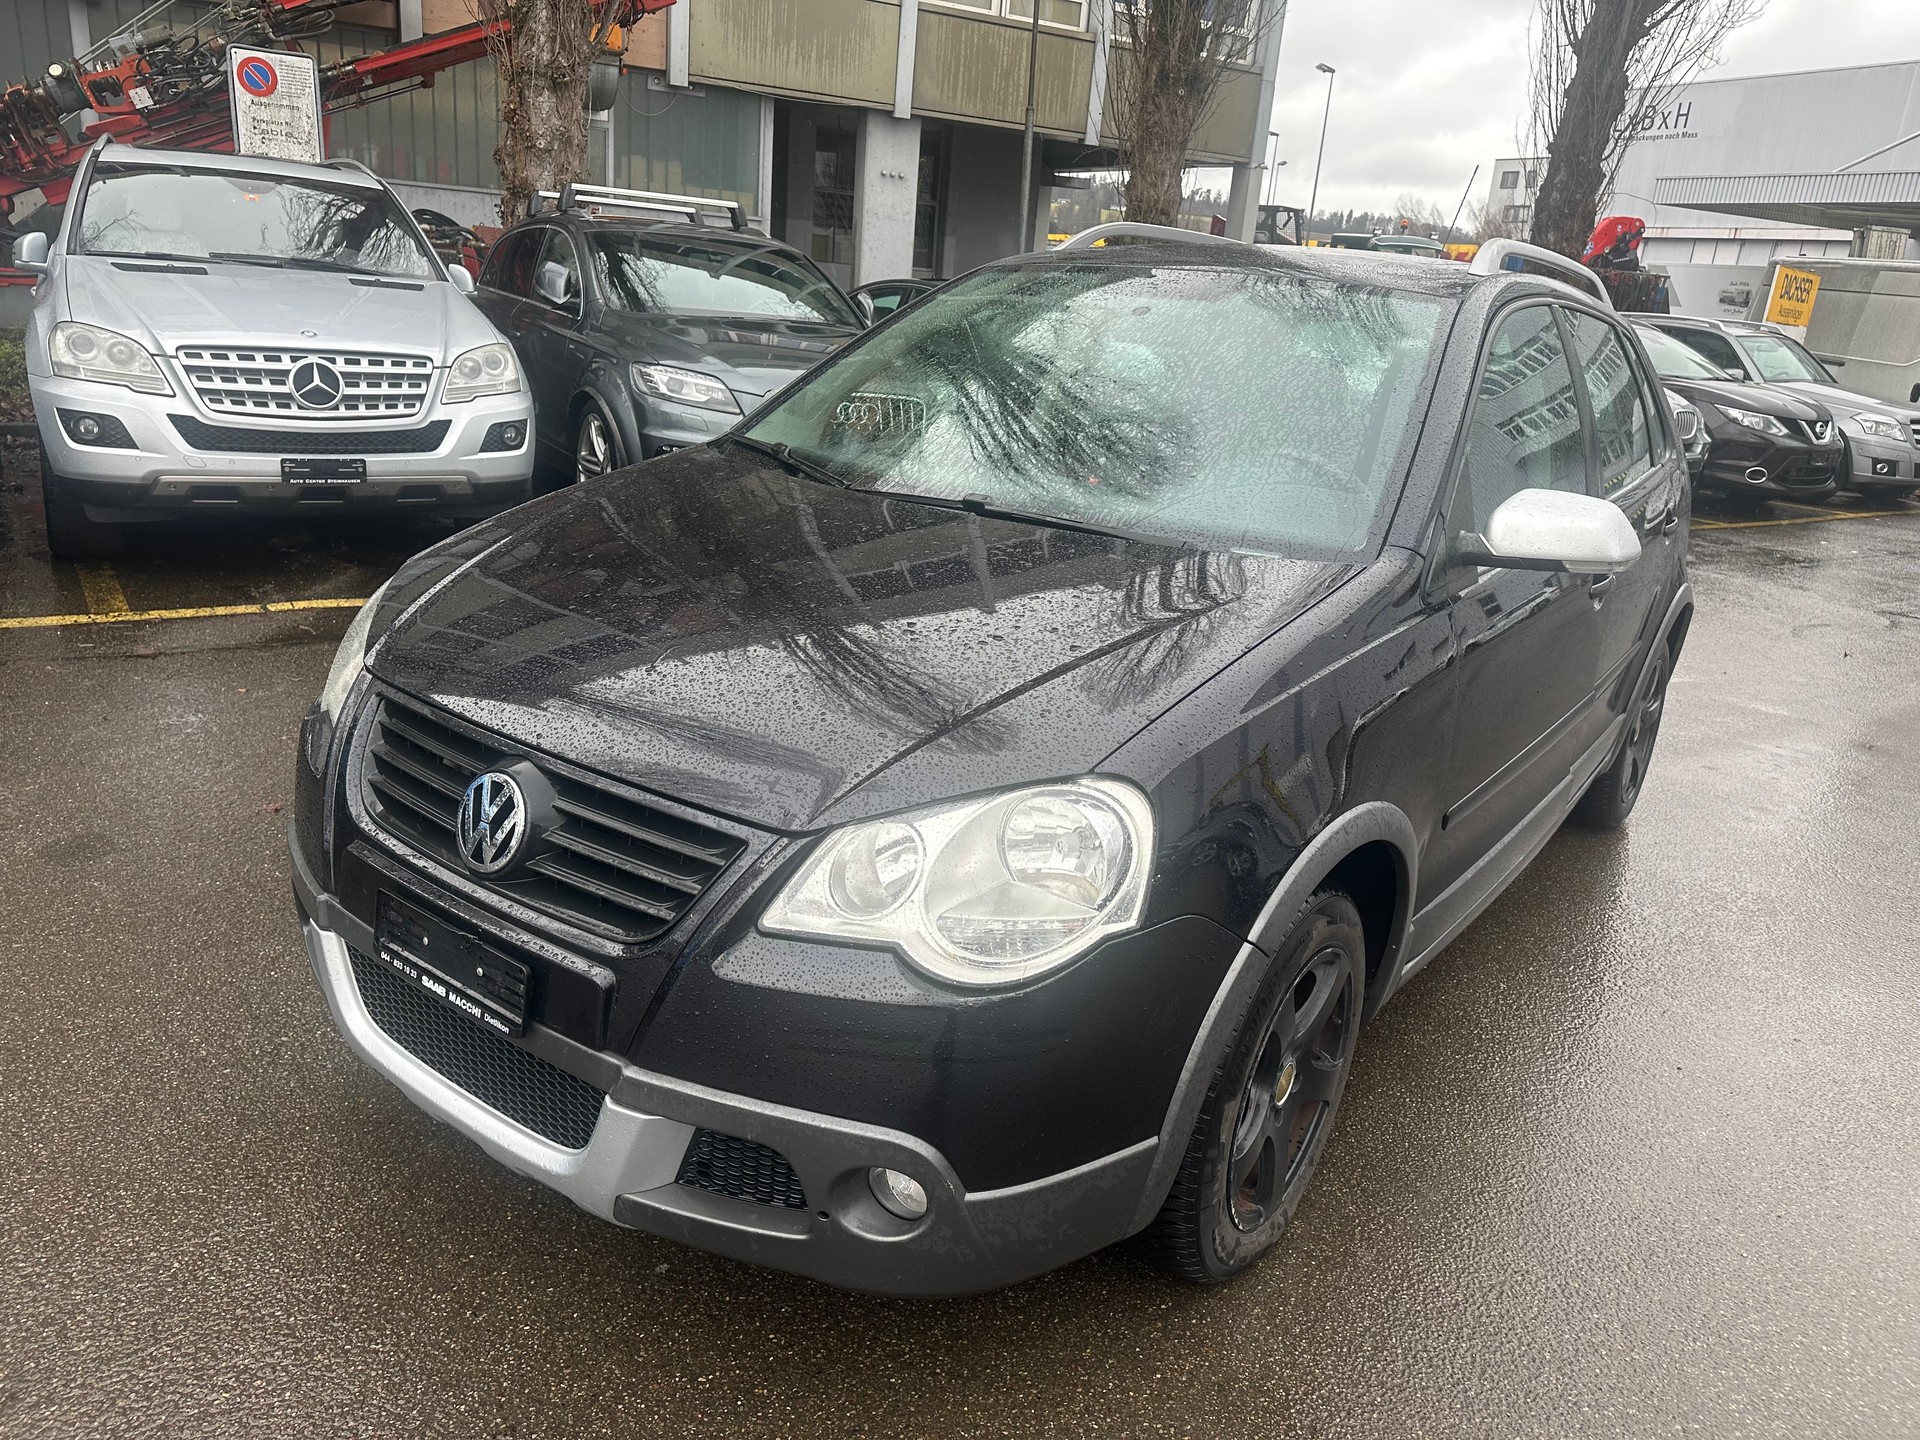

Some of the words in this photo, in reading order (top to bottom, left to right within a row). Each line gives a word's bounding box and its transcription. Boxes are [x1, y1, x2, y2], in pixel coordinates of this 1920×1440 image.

[1665, 131, 1679, 139] nach
[1681, 131, 1698, 139] Mass
[1779, 273, 1813, 304] DACHSER
[421, 975, 447, 997] SAAB
[448, 992, 481, 1018] MACCHI
[484, 1013, 510, 1034] Dietlikon
